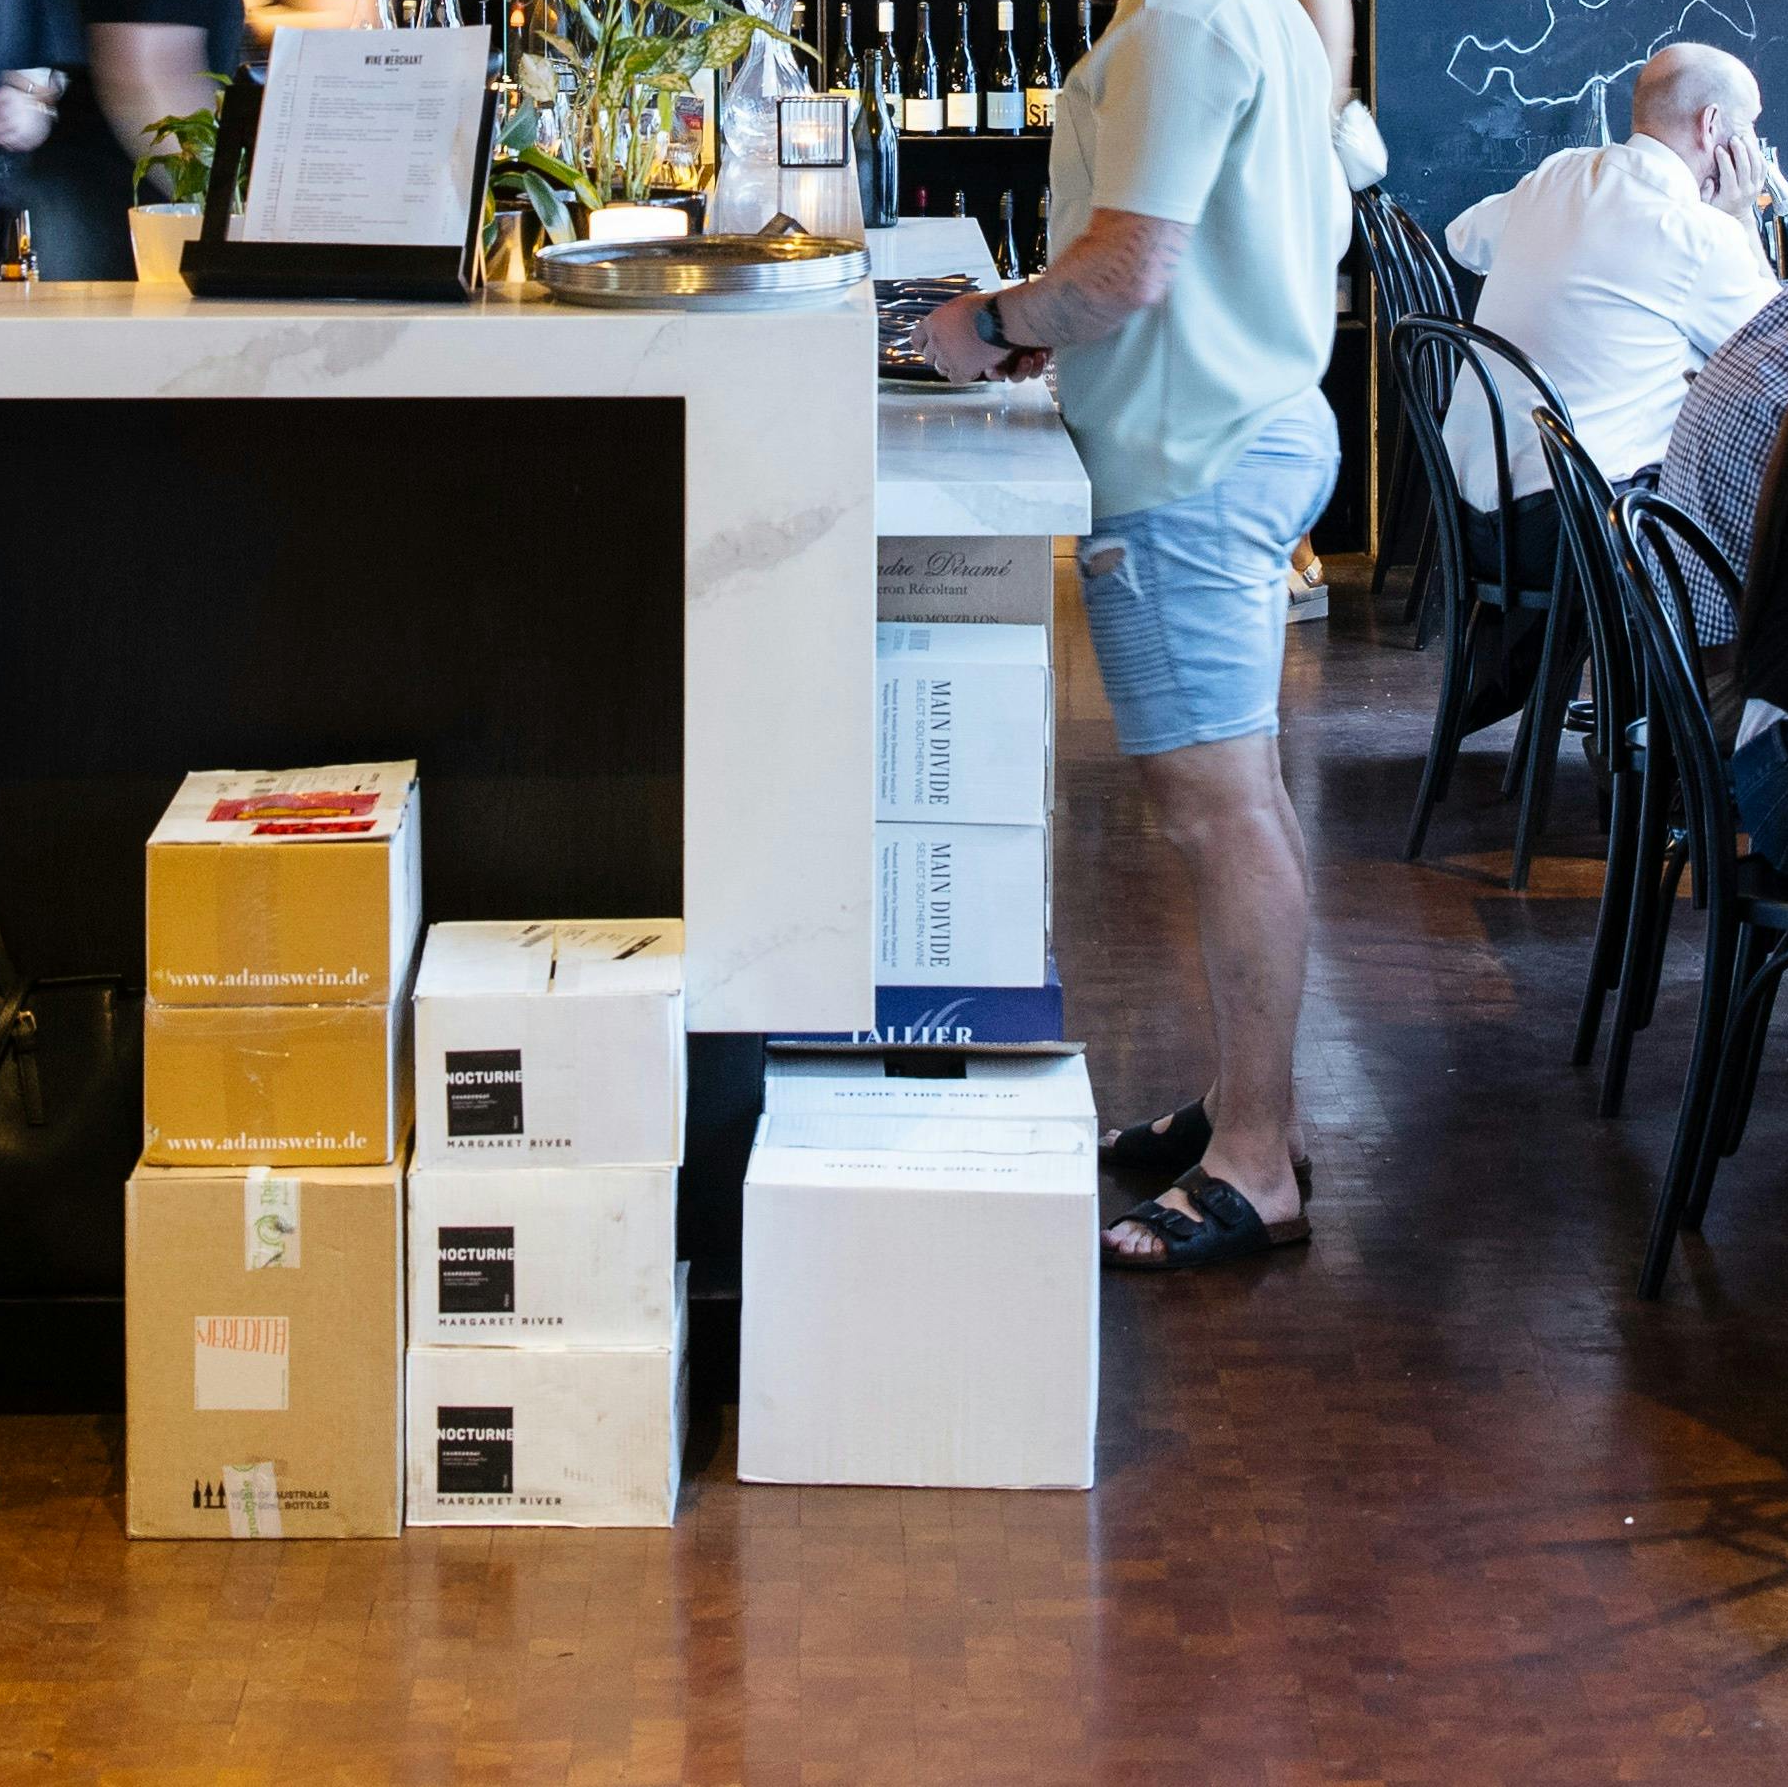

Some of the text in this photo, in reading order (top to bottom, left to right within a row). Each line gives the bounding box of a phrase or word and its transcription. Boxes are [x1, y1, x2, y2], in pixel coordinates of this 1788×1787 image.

[908, 582, 968, 595] Récoltant
[914, 679, 926, 805] SELECT SOUTHERN WINE
[929, 679, 952, 805] MAIN DIVIDE
[915, 842, 926, 968] SELECT SOUTHERN WINE
[929, 842, 952, 968] MAIN DIVIDE
[168, 967, 370, 987] www.adamswein.de
[445, 1070, 523, 1085] NOCTURNE
[167, 1131, 367, 1151] www.adamswein.de
[447, 1138, 573, 1148] MARGARET RIVER
[437, 1247, 515, 1261] NOCTURNE
[438, 1317, 564, 1326] MARGARET RIVER
[197, 1318, 286, 1356] MEREDITH
[436, 1427, 516, 1441] NOCTURNE
[284, 1501, 330, 1510] BOTTLES
[437, 1496, 562, 1505] MARGARET RIVER
